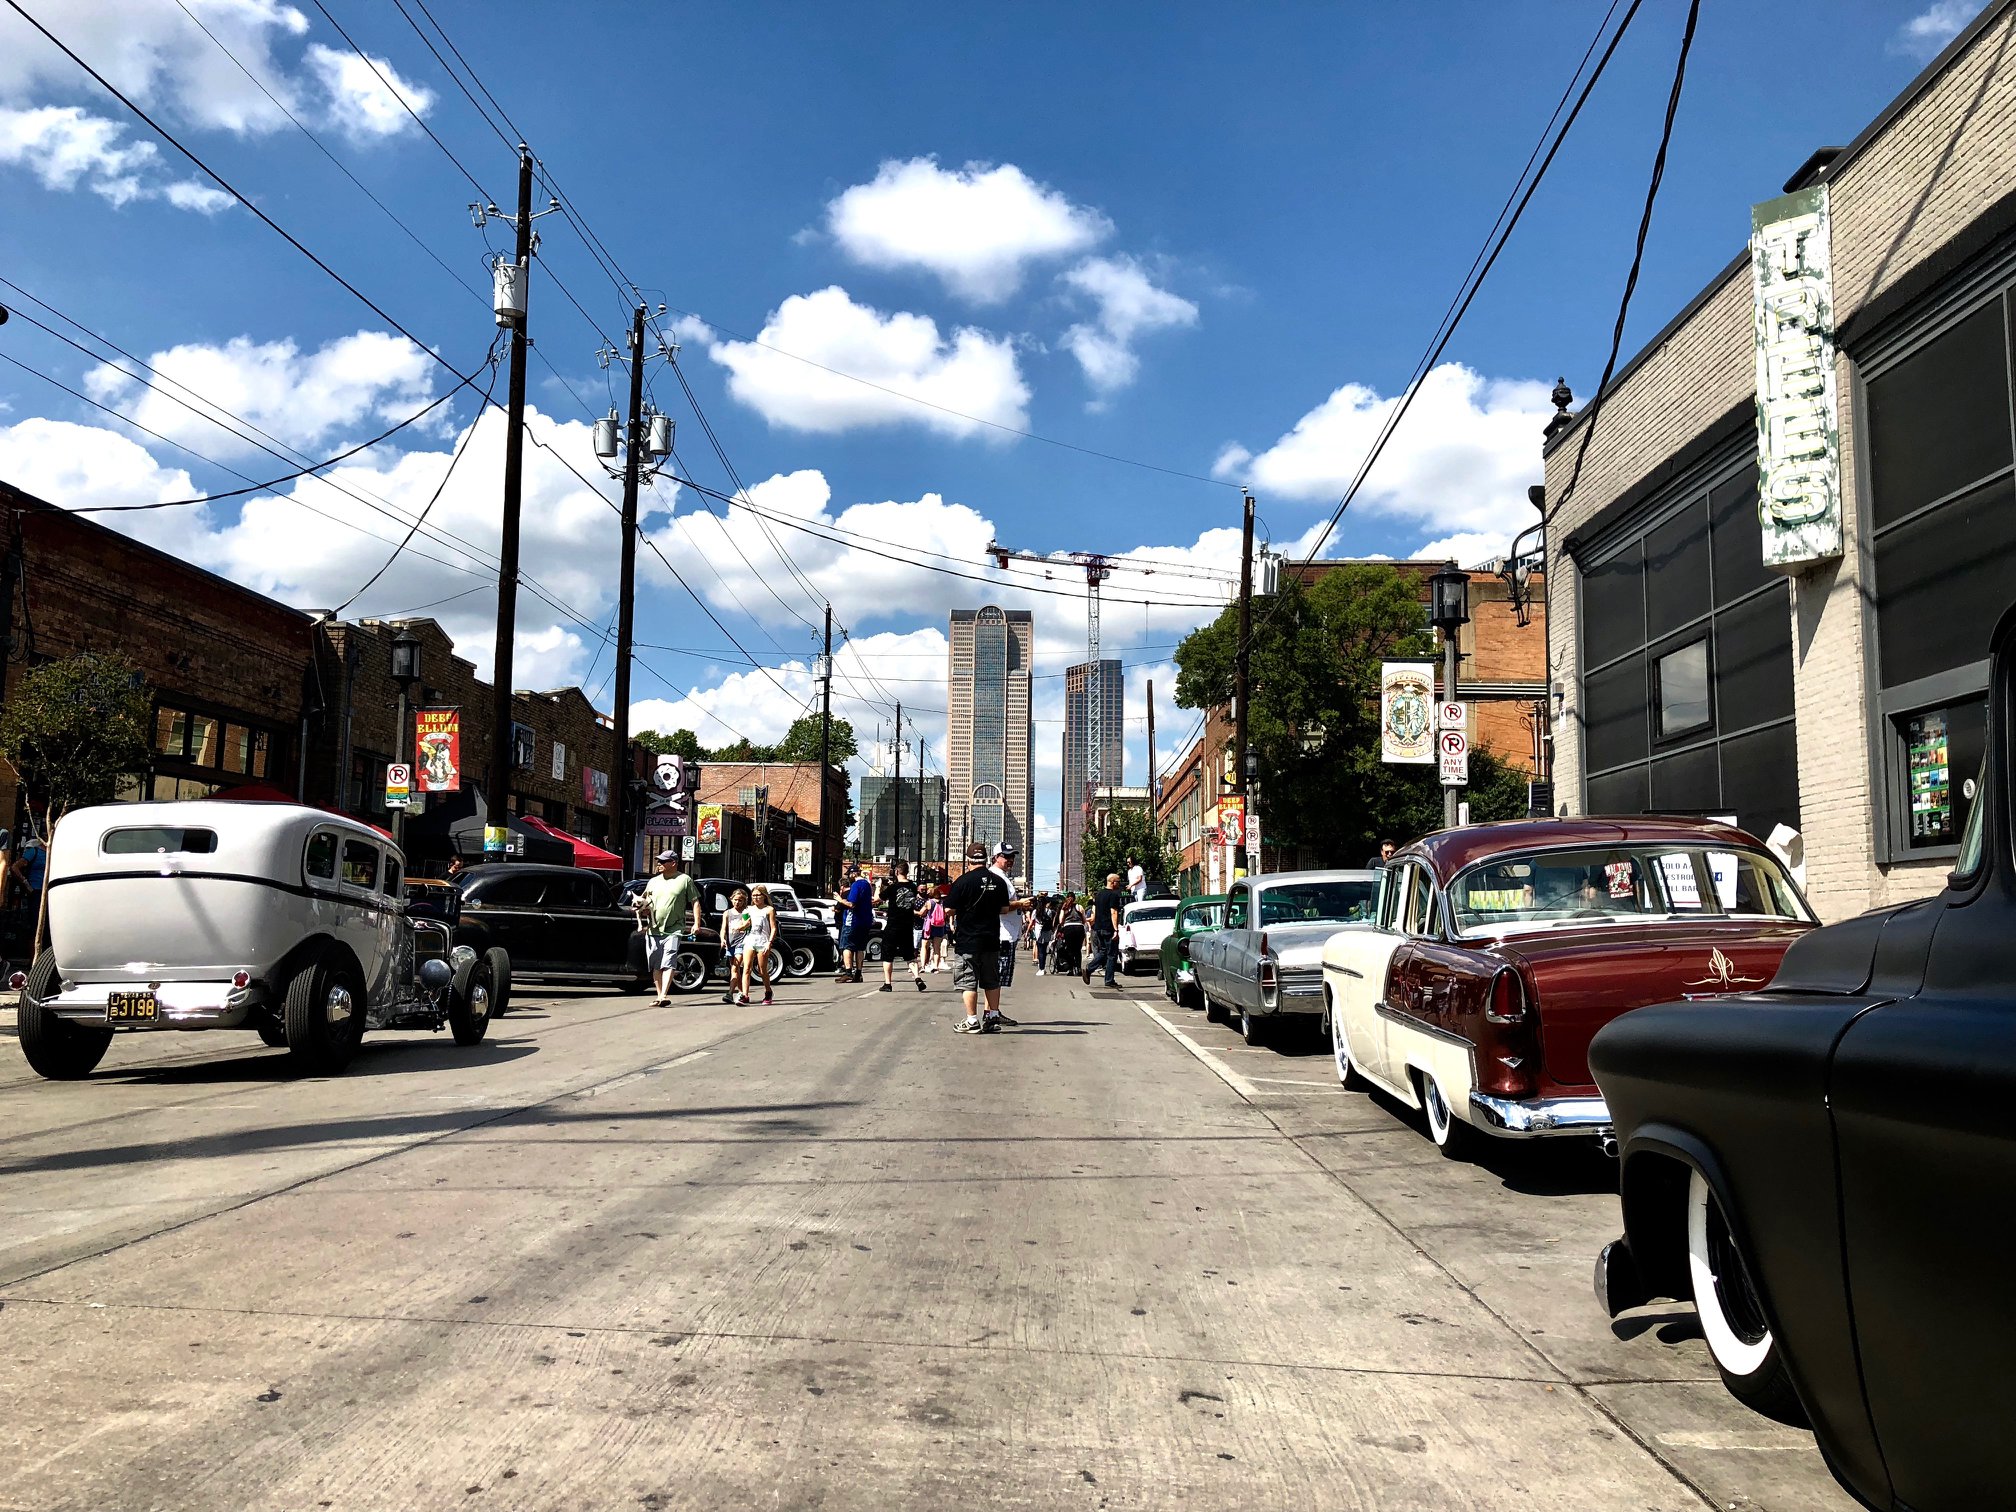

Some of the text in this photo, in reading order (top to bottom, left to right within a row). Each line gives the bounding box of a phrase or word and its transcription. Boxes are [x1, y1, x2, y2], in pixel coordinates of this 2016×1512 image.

[1762, 213, 1827, 526] TREES
[417, 723, 459, 733] ELLUM
[1443, 758, 1463, 766] ANY
[1443, 766, 1464, 774] TIME
[646, 816, 685, 827] GLAZED
[119, 998, 155, 1017] 3198
